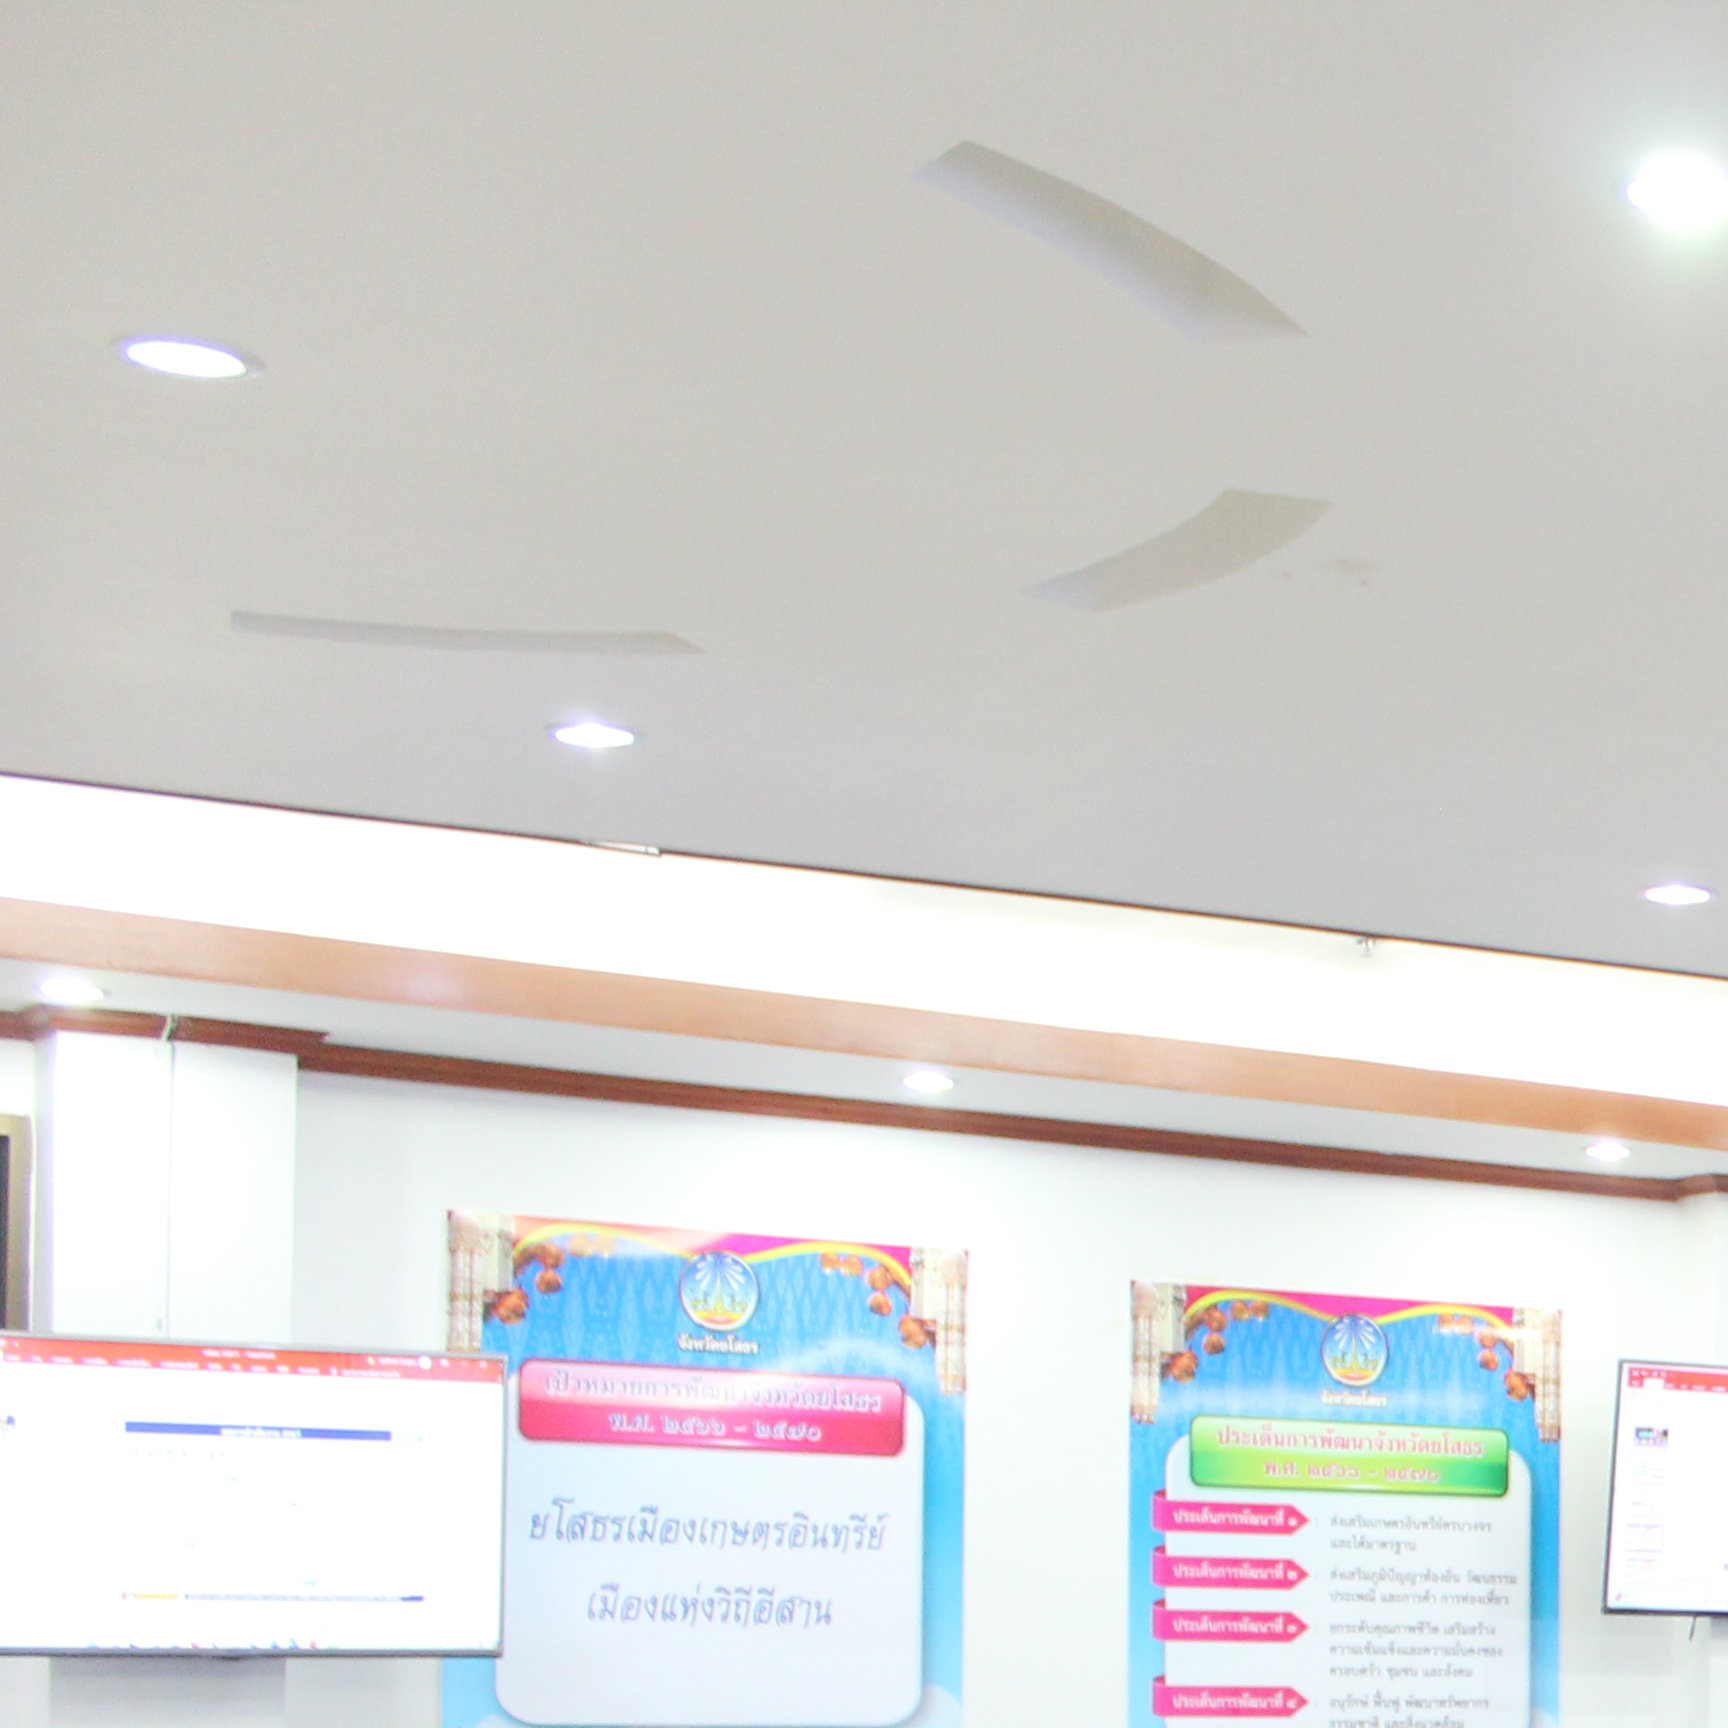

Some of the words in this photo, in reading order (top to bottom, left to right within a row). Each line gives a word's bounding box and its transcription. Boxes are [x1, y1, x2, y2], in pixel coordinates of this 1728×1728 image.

[678, 1333, 758, 1354] จังหวัดยโสธร
[544, 1367, 882, 1413] เป้าหมายการพัฒนาจังหวัดยโสธร
[1216, 1422, 1484, 1457] ประเด็นการพัฒนาจังหวัดยโสธร
[529, 1497, 890, 1551] ยโสธรเมืองเกษตรอินทรีย์
[587, 1581, 833, 1627] เมืองแห่งวิถีอีสาน
